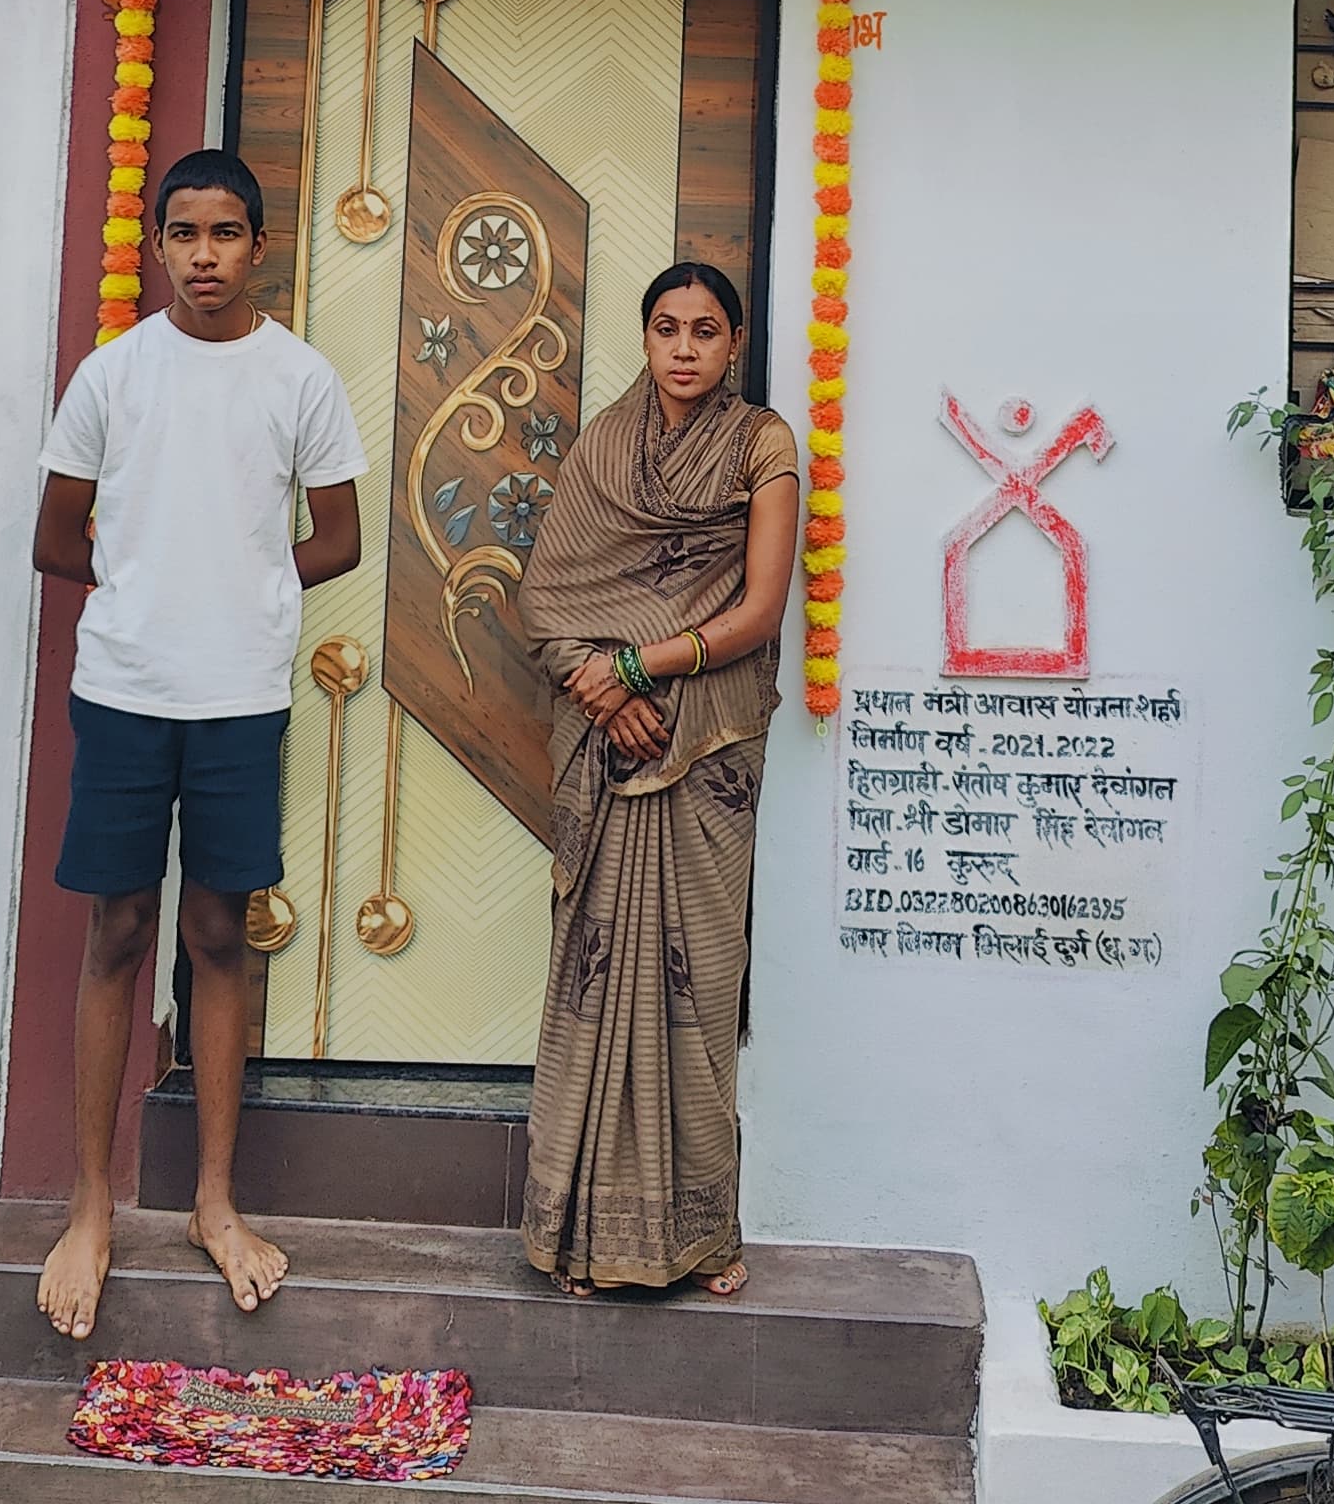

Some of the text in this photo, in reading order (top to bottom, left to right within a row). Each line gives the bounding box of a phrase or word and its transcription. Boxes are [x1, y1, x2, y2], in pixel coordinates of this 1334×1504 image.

[852, 688, 916, 716] प्रधान
[923, 684, 972, 716] मंत्री
[974, 692, 1060, 720] आवास
[846, 719, 932, 756] निर्माण
[934, 723, 976, 758] वर्ष
[1015, 772, 1088, 809] कुमार
[1090, 765, 1178, 809] देवांगन
[941, 802, 1019, 844] डोमार
[1032, 806, 1078, 851] सिंह
[904, 846, 926, 873] 16
[839, 924, 892, 958] नगर
[895, 920, 968, 961] निगम
[971, 923, 1052, 966] भिलाई
[1051, 927, 1093, 968] दुर्ग
